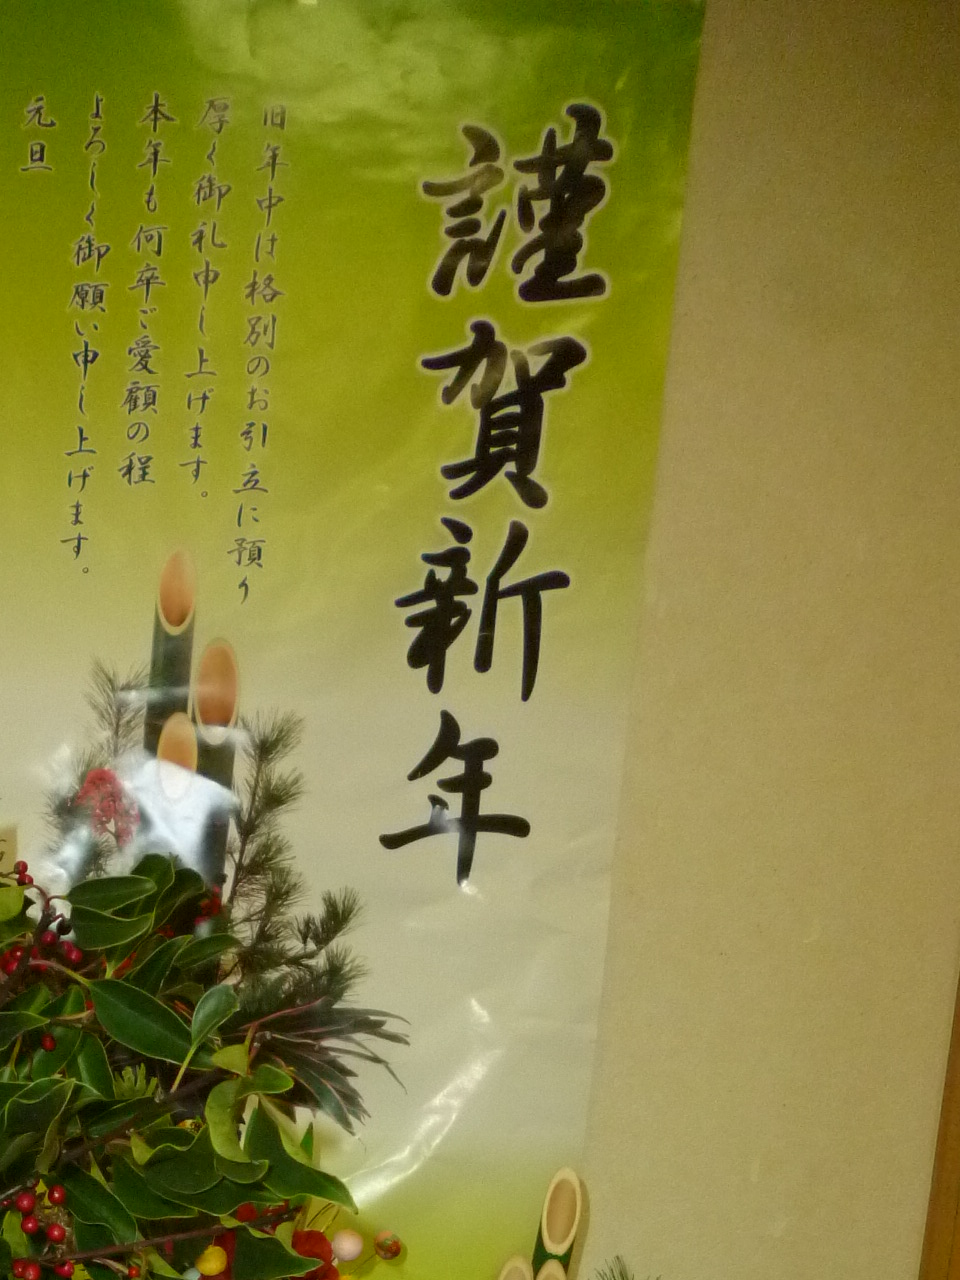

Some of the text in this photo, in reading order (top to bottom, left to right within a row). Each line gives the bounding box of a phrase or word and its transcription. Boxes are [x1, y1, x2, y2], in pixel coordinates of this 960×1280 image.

[20, 95, 56, 172] 元旦
[60, 93, 111, 575] よろしく御願い申し上げます。
[118, 91, 175, 485] 本年も何卒ご愛顧の程
[179, 96, 232, 499] 厚く御礼申し上げます。
[227, 102, 288, 605] 旧年中は格別のお引立に預り
[378, 103, 615, 886] 謹賀新年
